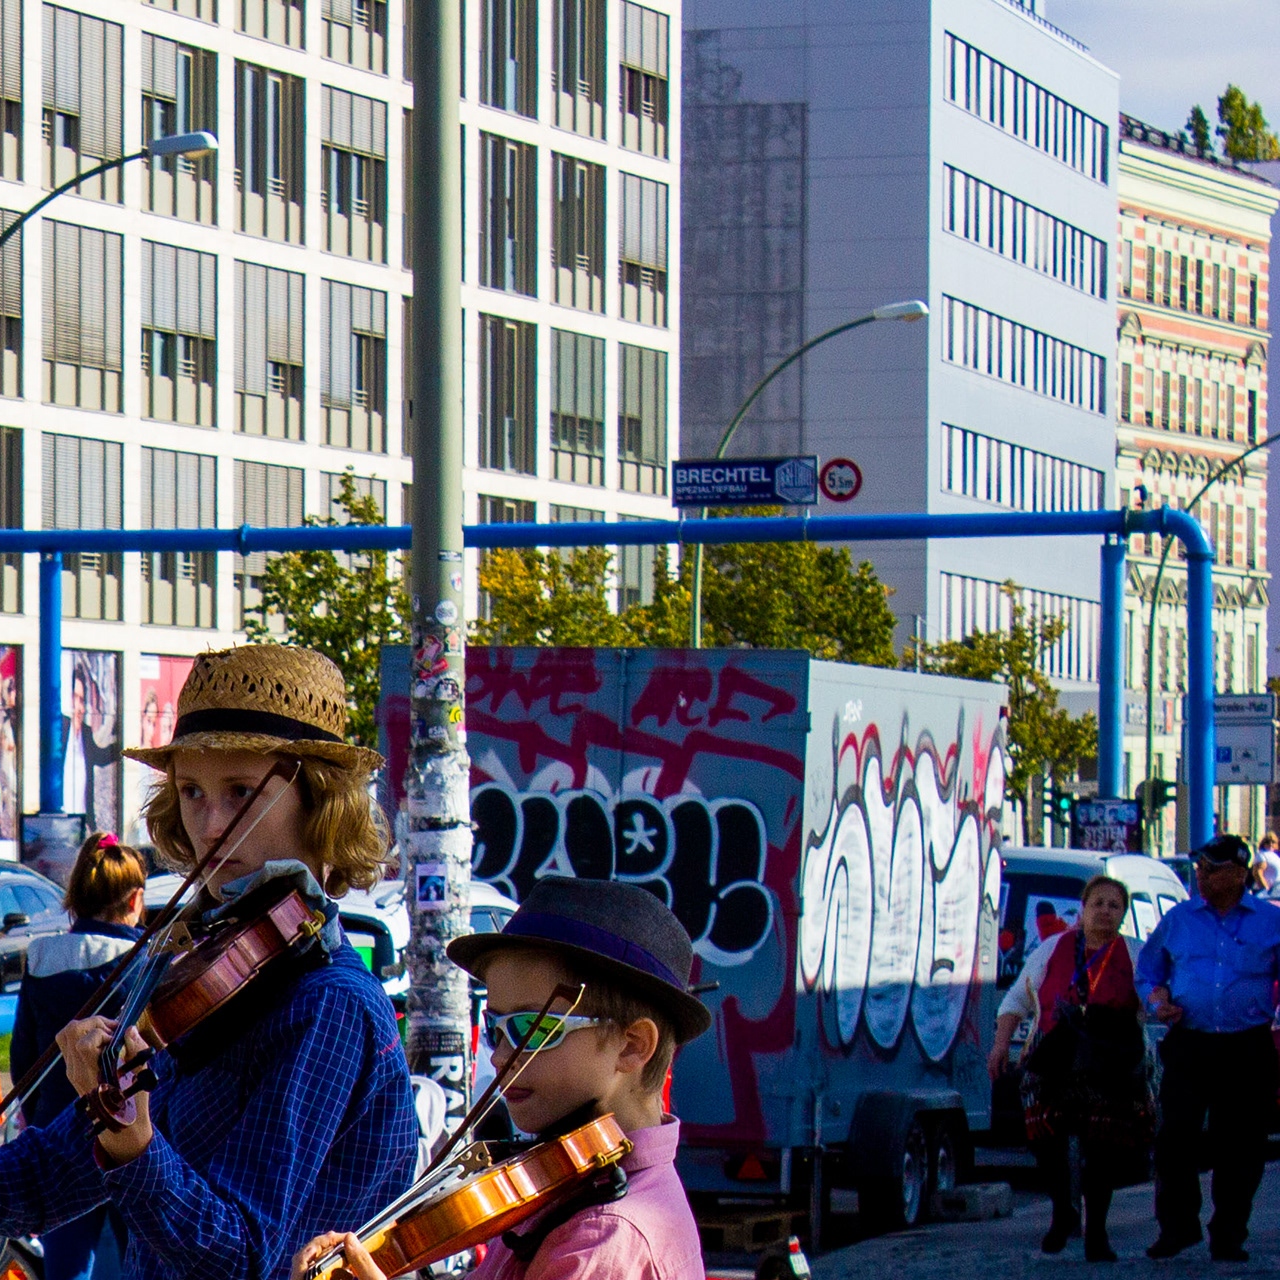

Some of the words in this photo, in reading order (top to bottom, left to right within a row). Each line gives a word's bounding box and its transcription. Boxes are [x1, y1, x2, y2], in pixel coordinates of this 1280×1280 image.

[676, 467, 771, 484] BRECHTEL
[676, 485, 748, 494] SPEZIALTIEFBAU
[1084, 826, 1127, 841] SYSTEM
